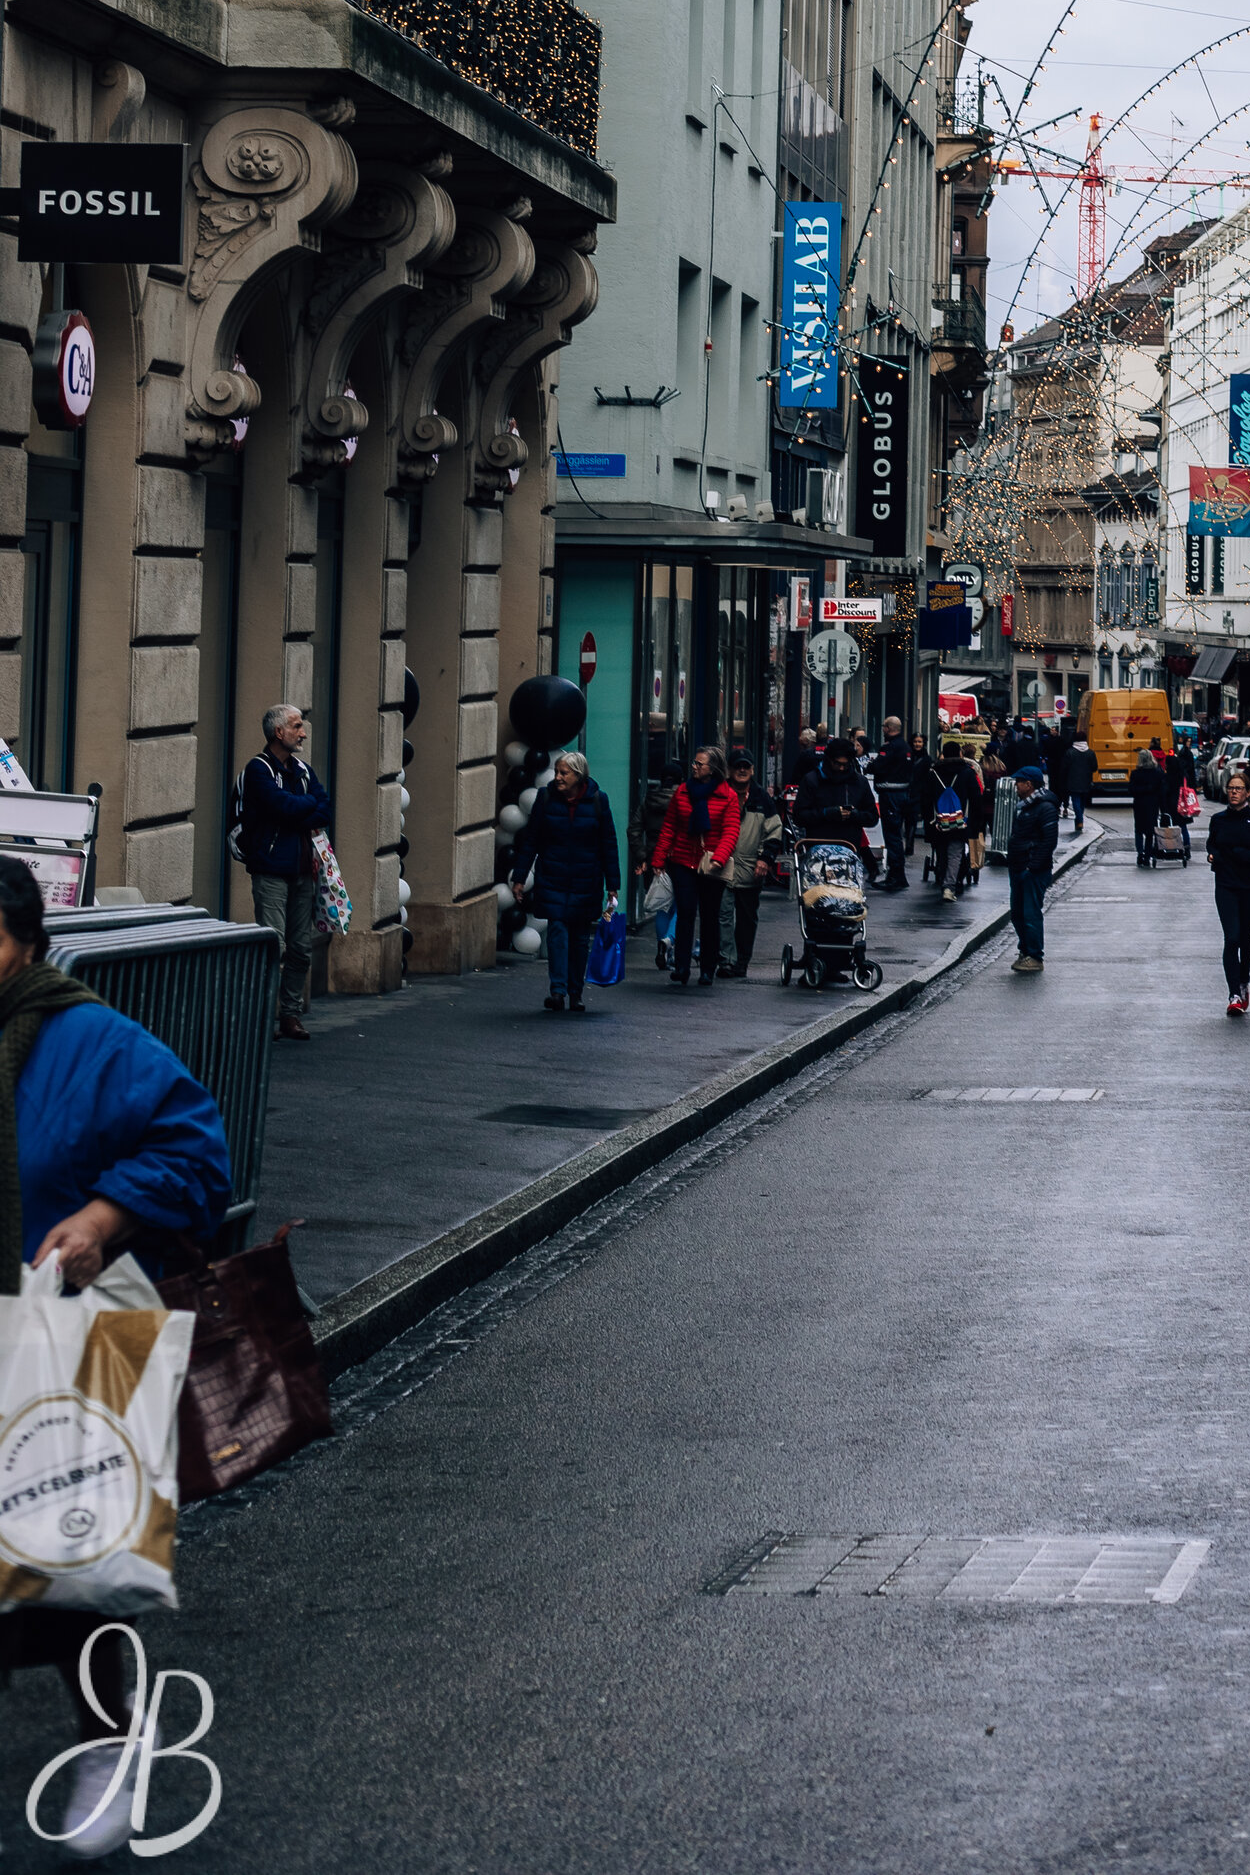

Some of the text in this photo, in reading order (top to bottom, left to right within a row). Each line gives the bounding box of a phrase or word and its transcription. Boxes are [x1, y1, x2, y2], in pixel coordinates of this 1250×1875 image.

[37, 189, 162, 217] FOSSIL
[790, 216, 830, 393] VISILAB
[67, 343, 92, 397] C&A
[872, 390, 893, 521] GLOBUS
[1190, 534, 1200, 583] GLOBUS
[946, 575, 980, 585] ONLY
[837, 601, 860, 609] Inter
[837, 608, 877, 616] Discount
[1148, 581, 1156, 620] DEPOT
[952, 713, 973, 725] dpd
[1110, 716, 1150, 725] DHL
[0, 1486, 38, 1517] ET'S
